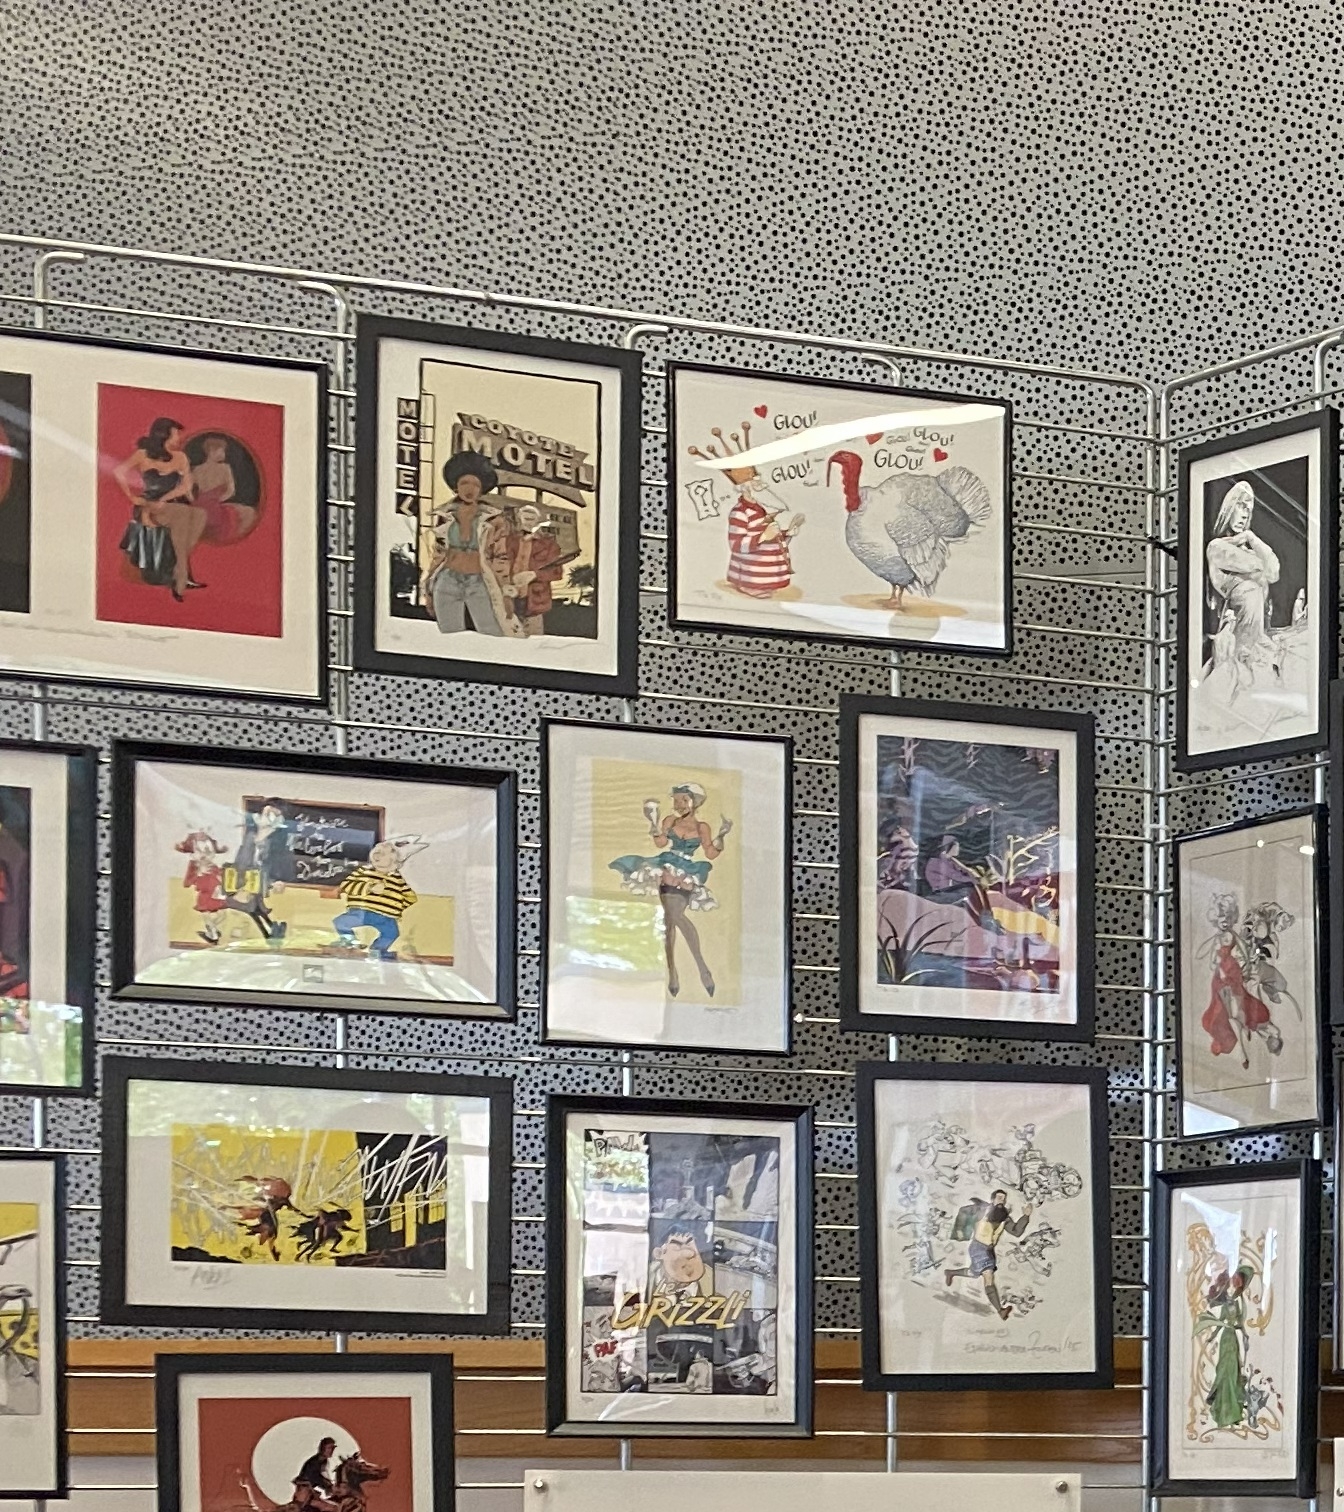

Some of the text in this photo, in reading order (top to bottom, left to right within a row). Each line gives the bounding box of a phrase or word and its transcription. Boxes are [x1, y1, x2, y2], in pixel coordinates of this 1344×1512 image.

[773, 410, 818, 431] GLOU!
[469, 413, 575, 459] COYOTE
[913, 427, 955, 447] GLOU!
[398, 400, 419, 516] MOTEL
[461, 429, 594, 487] MOTEL
[873, 448, 924, 471] GLOU!
[770, 460, 811, 484] GLOU!
[594, 1340, 619, 1358] PAF
